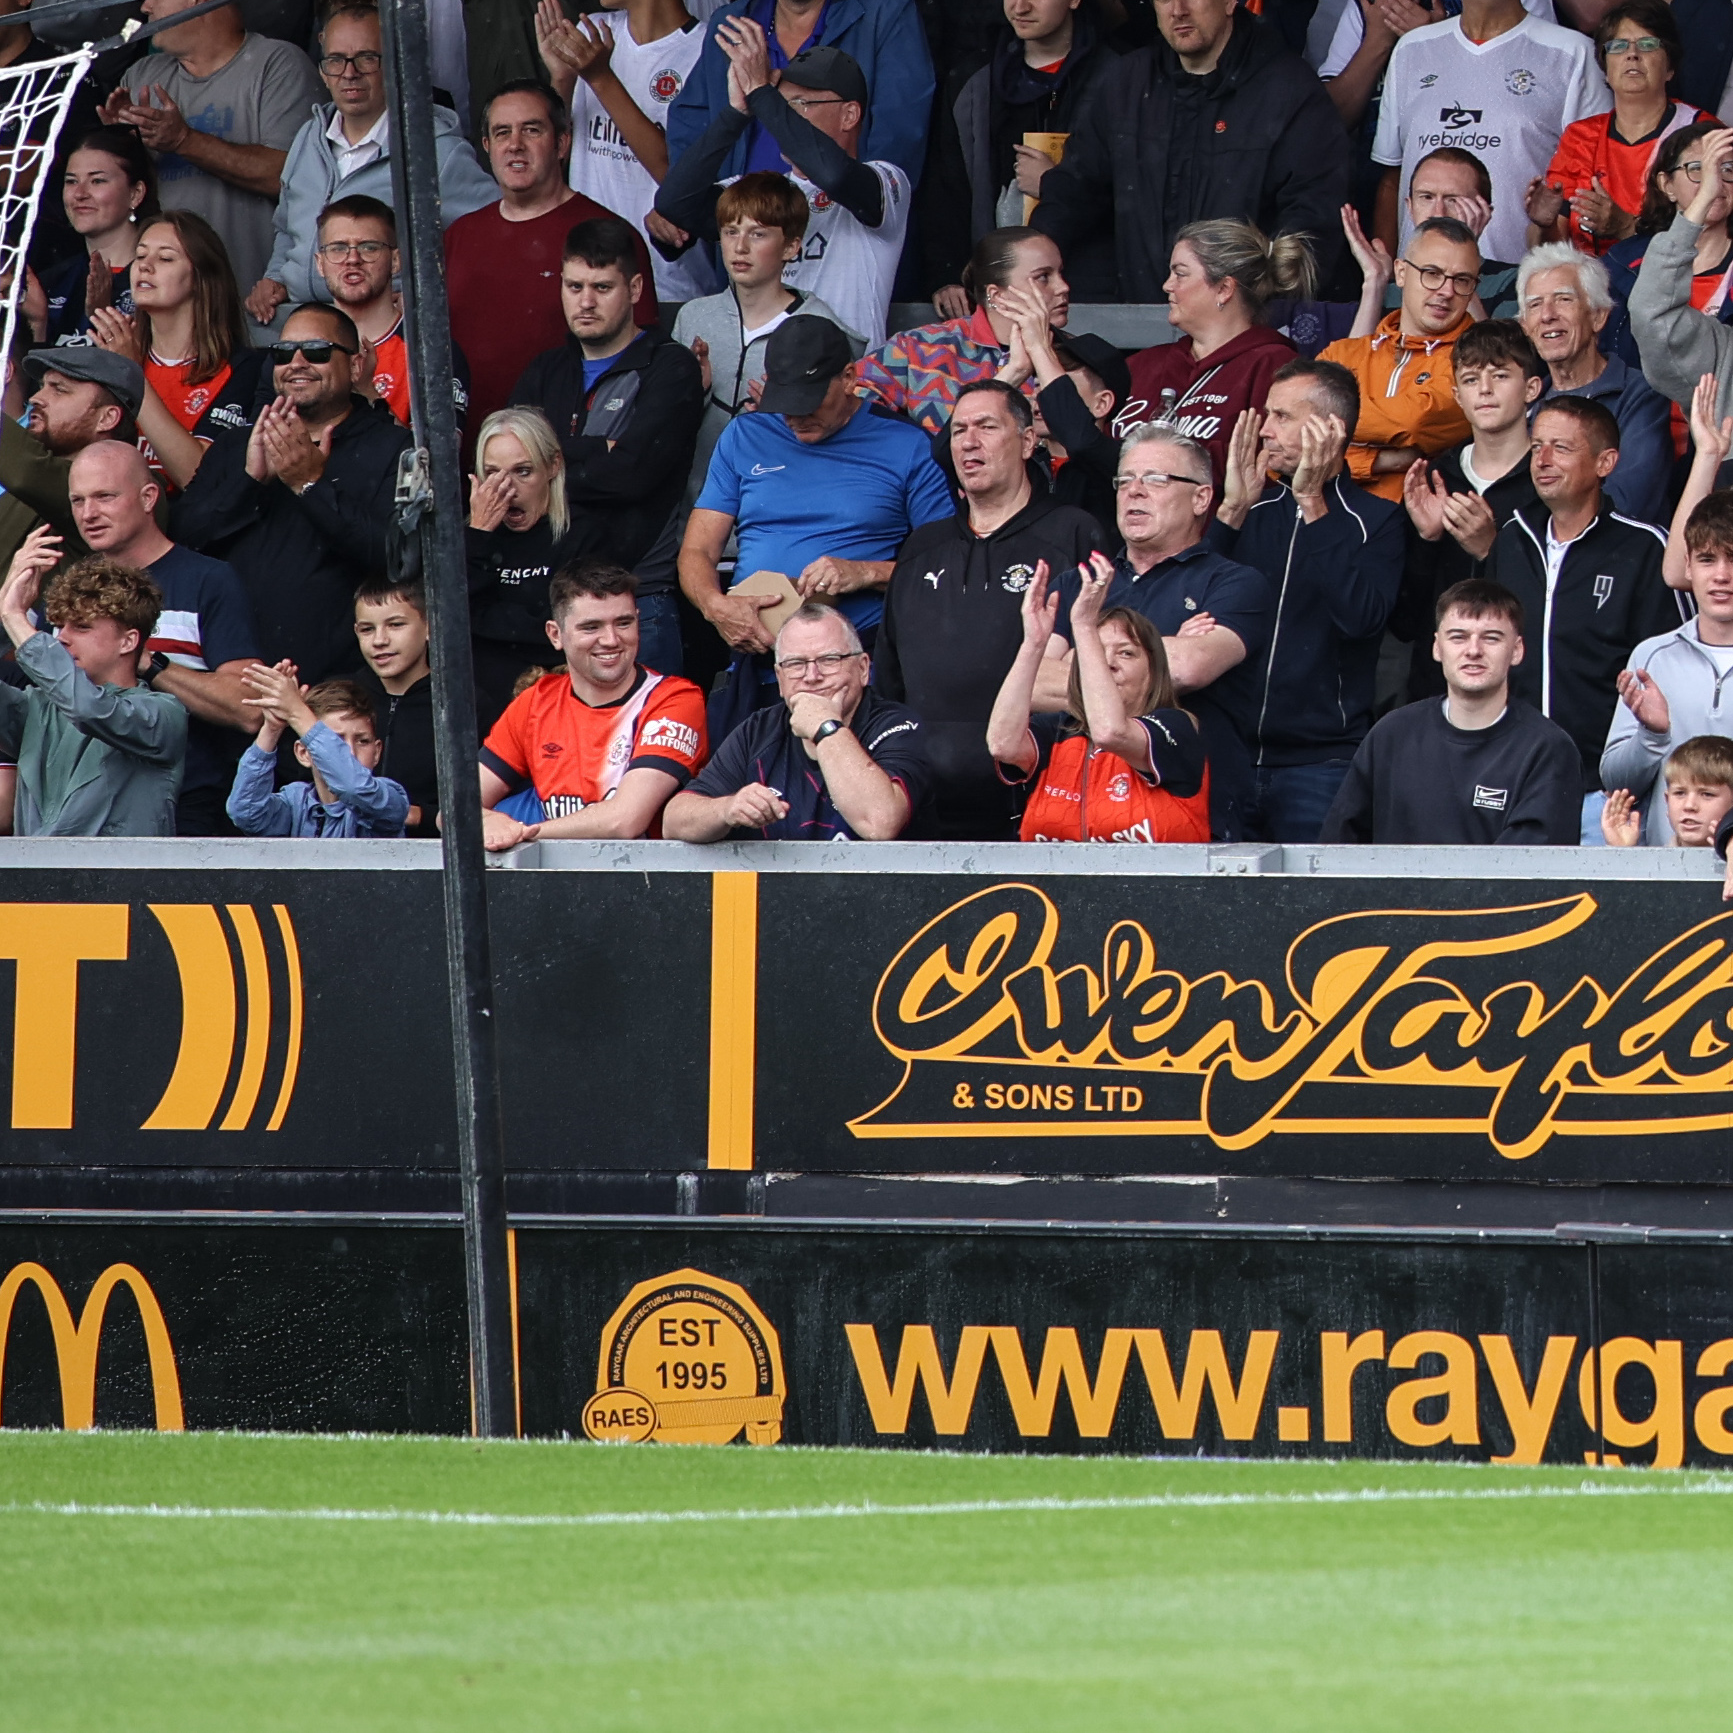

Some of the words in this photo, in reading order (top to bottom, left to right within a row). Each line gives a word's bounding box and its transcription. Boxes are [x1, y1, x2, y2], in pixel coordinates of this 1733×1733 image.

[952, 1082, 976, 1109] &
[984, 1083, 1075, 1112] SONS
[1084, 1084, 1144, 1113] LTD
[658, 1317, 721, 1347] EST
[655, 1360, 728, 1391] 1995
[592, 1406, 651, 1430] RAES
